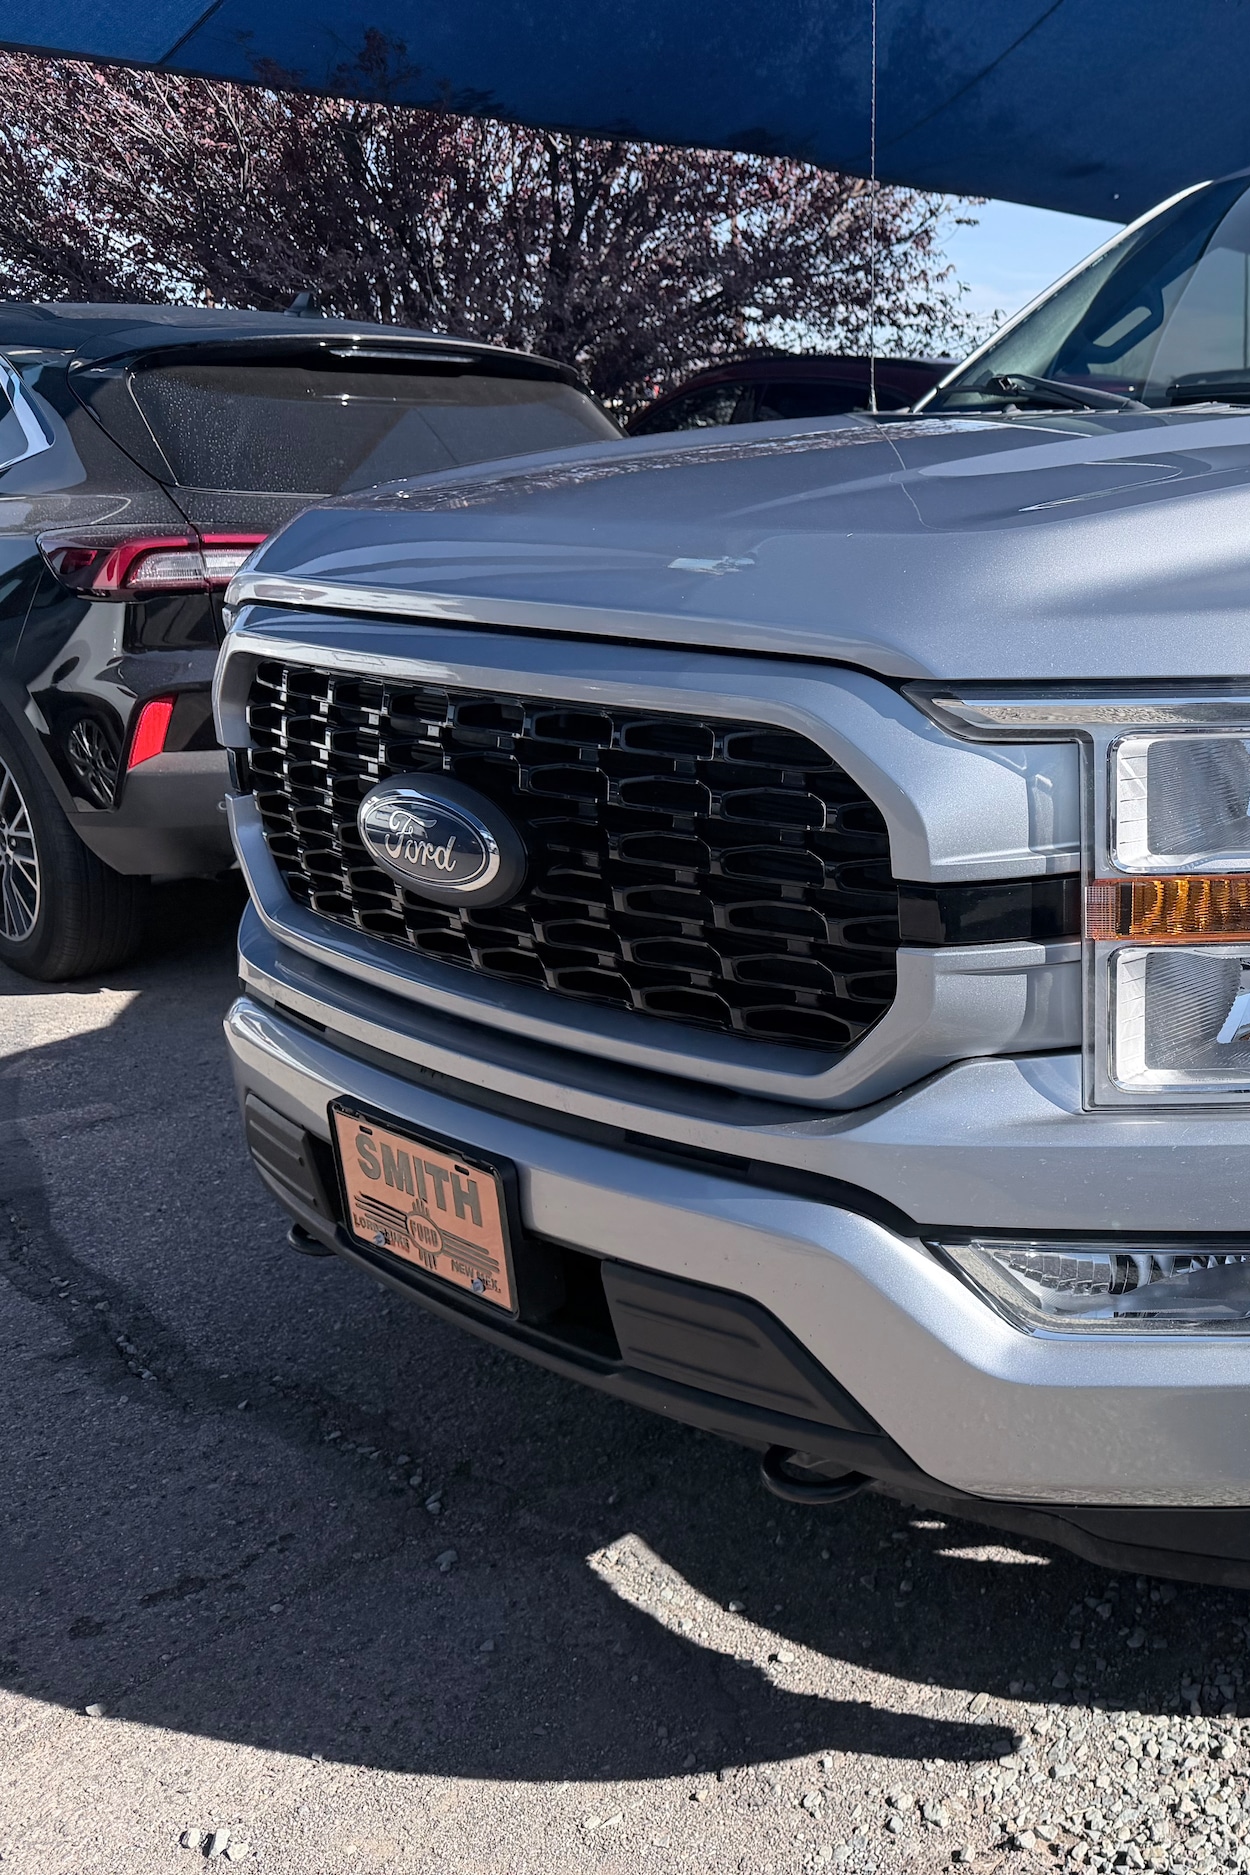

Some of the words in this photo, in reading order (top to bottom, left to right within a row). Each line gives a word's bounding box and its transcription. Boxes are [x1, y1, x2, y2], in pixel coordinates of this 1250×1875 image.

[384, 810, 457, 872] Ford
[355, 1133, 483, 1228] SMITH
[409, 1219, 438, 1248] FORD
[451, 1259, 474, 1278] NEW
